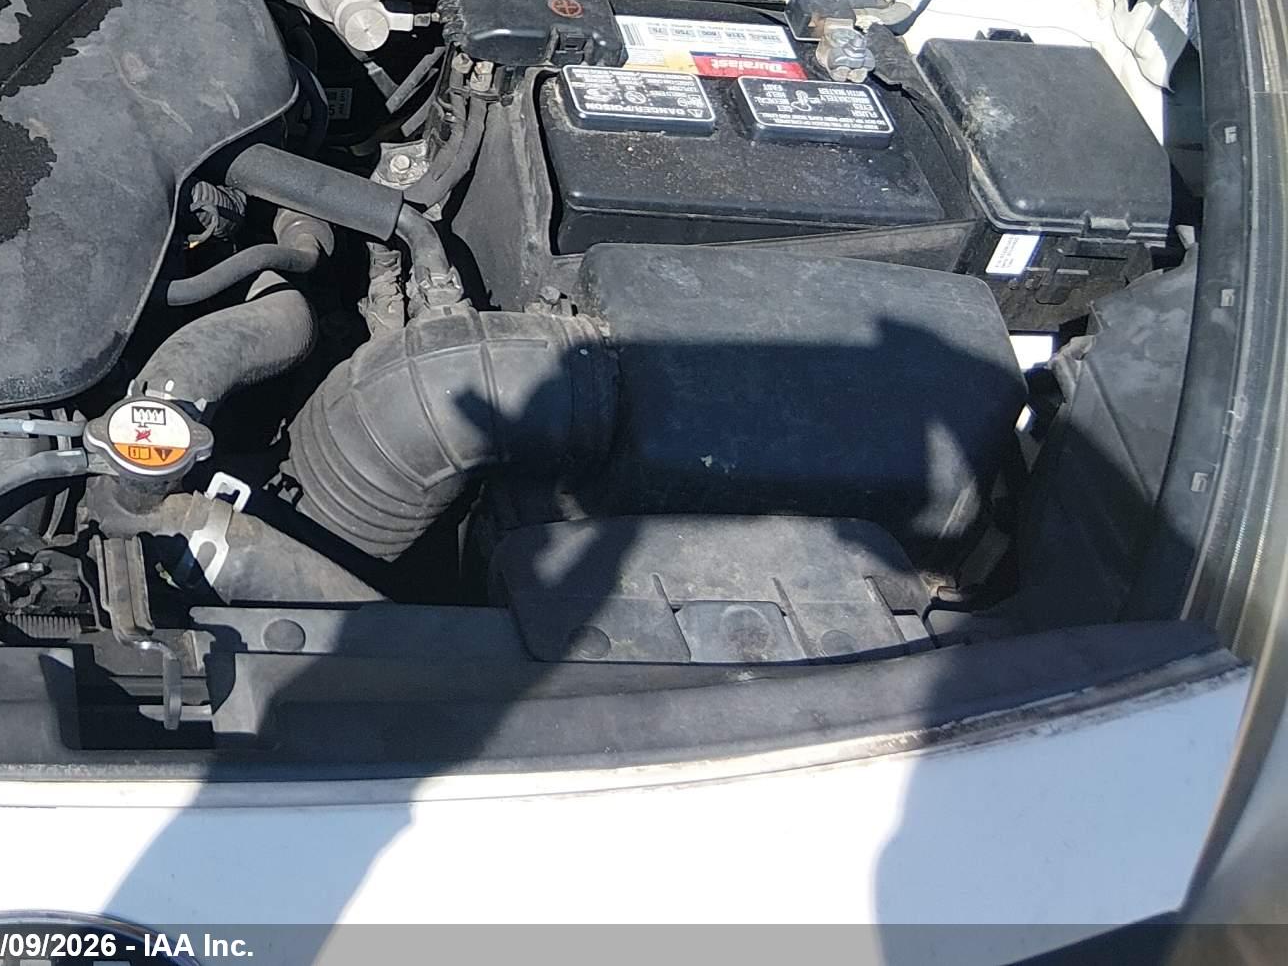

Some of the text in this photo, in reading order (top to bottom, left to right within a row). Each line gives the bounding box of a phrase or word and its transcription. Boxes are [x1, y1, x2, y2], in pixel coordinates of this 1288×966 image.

[708, 57, 787, 74] Duralast
[763, 90, 787, 98] HELP
[816, 87, 868, 97] WITH WATER
[752, 96, 790, 105] MEDICAL
[583, 101, 686, 115] DANGER/POISON
[851, 103, 875, 111] EYES
[849, 109, 879, 118] FLUSH
